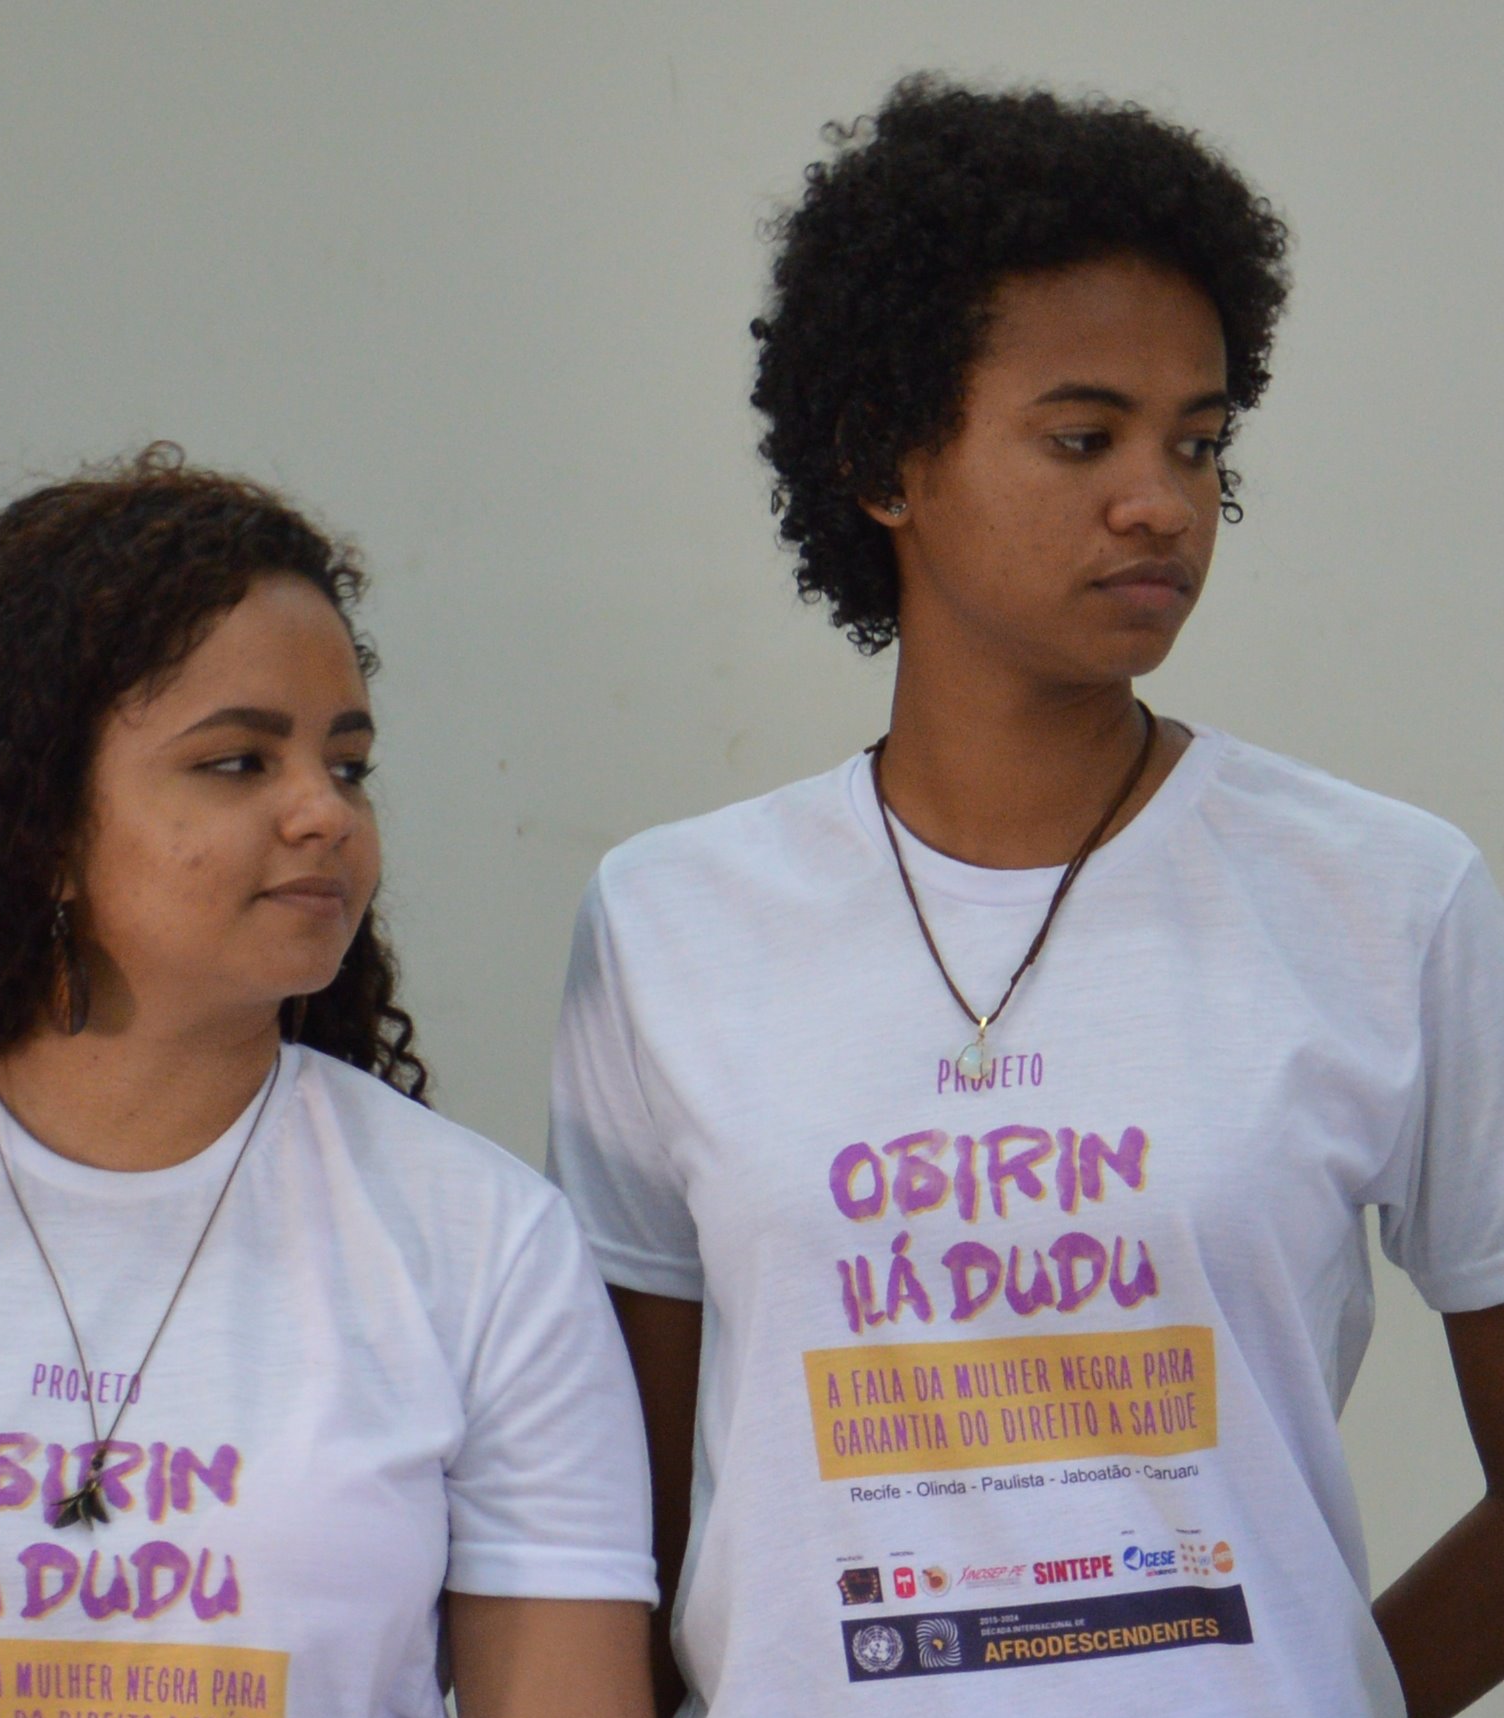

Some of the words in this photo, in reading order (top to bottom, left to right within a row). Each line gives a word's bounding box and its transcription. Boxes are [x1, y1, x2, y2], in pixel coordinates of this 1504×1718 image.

[828, 1123, 1149, 1223] OBIRIN
[836, 1230, 935, 1335] ILÁ
[940, 1231, 1160, 1322] DUDU
[32, 1362, 141, 1405] PROJETO
[827, 1372, 842, 1409] A
[851, 1367, 905, 1406] FALA
[914, 1365, 944, 1402] DA
[954, 1357, 1051, 1400] MULHER
[1061, 1354, 1133, 1392] NEGRA
[1144, 1348, 1195, 1387] PARA
[832, 1413, 949, 1457] GARANTIA
[959, 1409, 990, 1447] DO
[1000, 1401, 1098, 1443] DIREITO
[1109, 1401, 1123, 1436] A
[1129, 1390, 1198, 1437] SAÚDE
[849, 1483, 902, 1503] Recife
[916, 1479, 967, 1497] Olinda
[982, 1474, 1045, 1493] Paulista
[1059, 1465, 1132, 1486] Jaboatão
[1143, 1464, 1200, 1482] Caruaru
[18, 1541, 243, 1623] DUDU
[1032, 1554, 1114, 1585] SINTEPE
[1145, 1550, 1176, 1568] CESE
[984, 1617, 1220, 1664] AFRODESCENDENTES
[16, 1661, 113, 1702] MULHER
[126, 1665, 199, 1706] NEGRA
[212, 1669, 267, 1710] PARA
